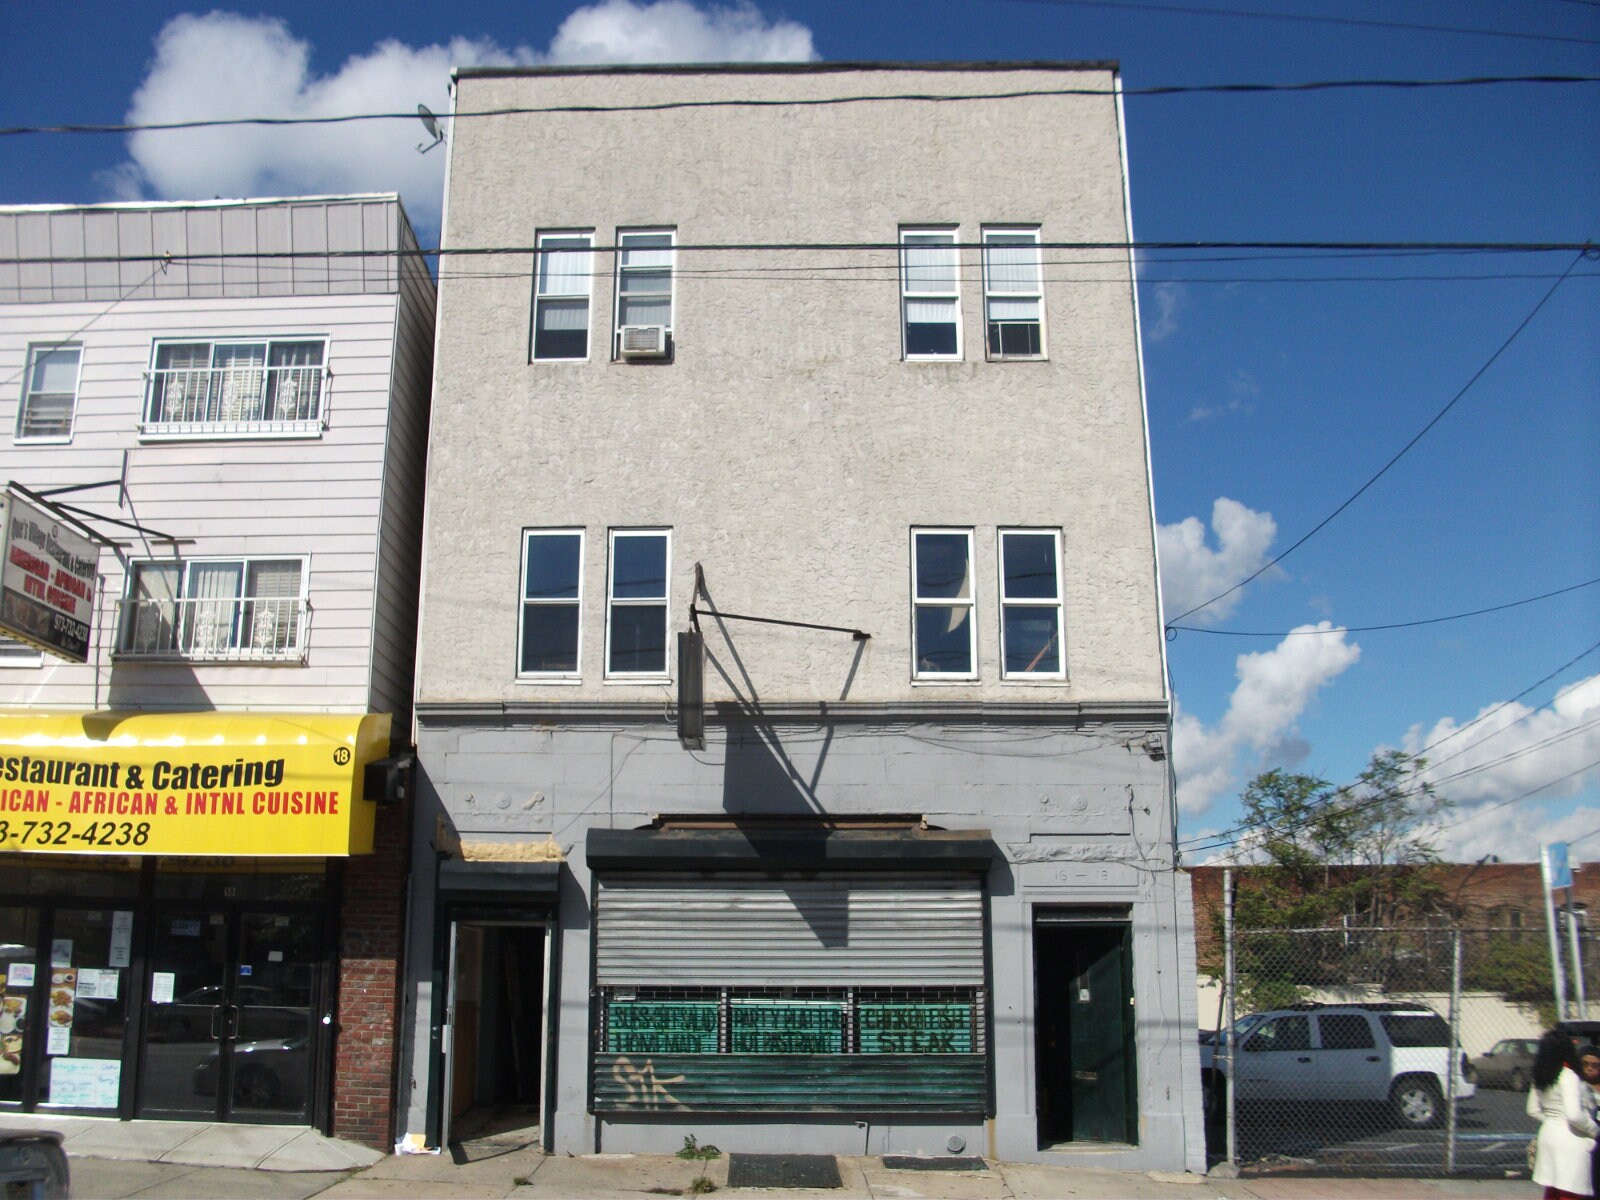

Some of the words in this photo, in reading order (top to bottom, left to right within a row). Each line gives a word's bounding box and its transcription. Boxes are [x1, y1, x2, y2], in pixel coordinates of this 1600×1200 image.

[55, 569, 86, 600] AFRICAN
[334, 748, 348, 764] 18
[125, 765, 144, 790] &
[152, 758, 285, 790] Catering
[68, 791, 158, 815] AFRICAN
[164, 796, 178, 815] &
[186, 792, 245, 815] INTNL
[252, 791, 339, 815] CUISINE
[877, 1030, 956, 1052] STEAK
